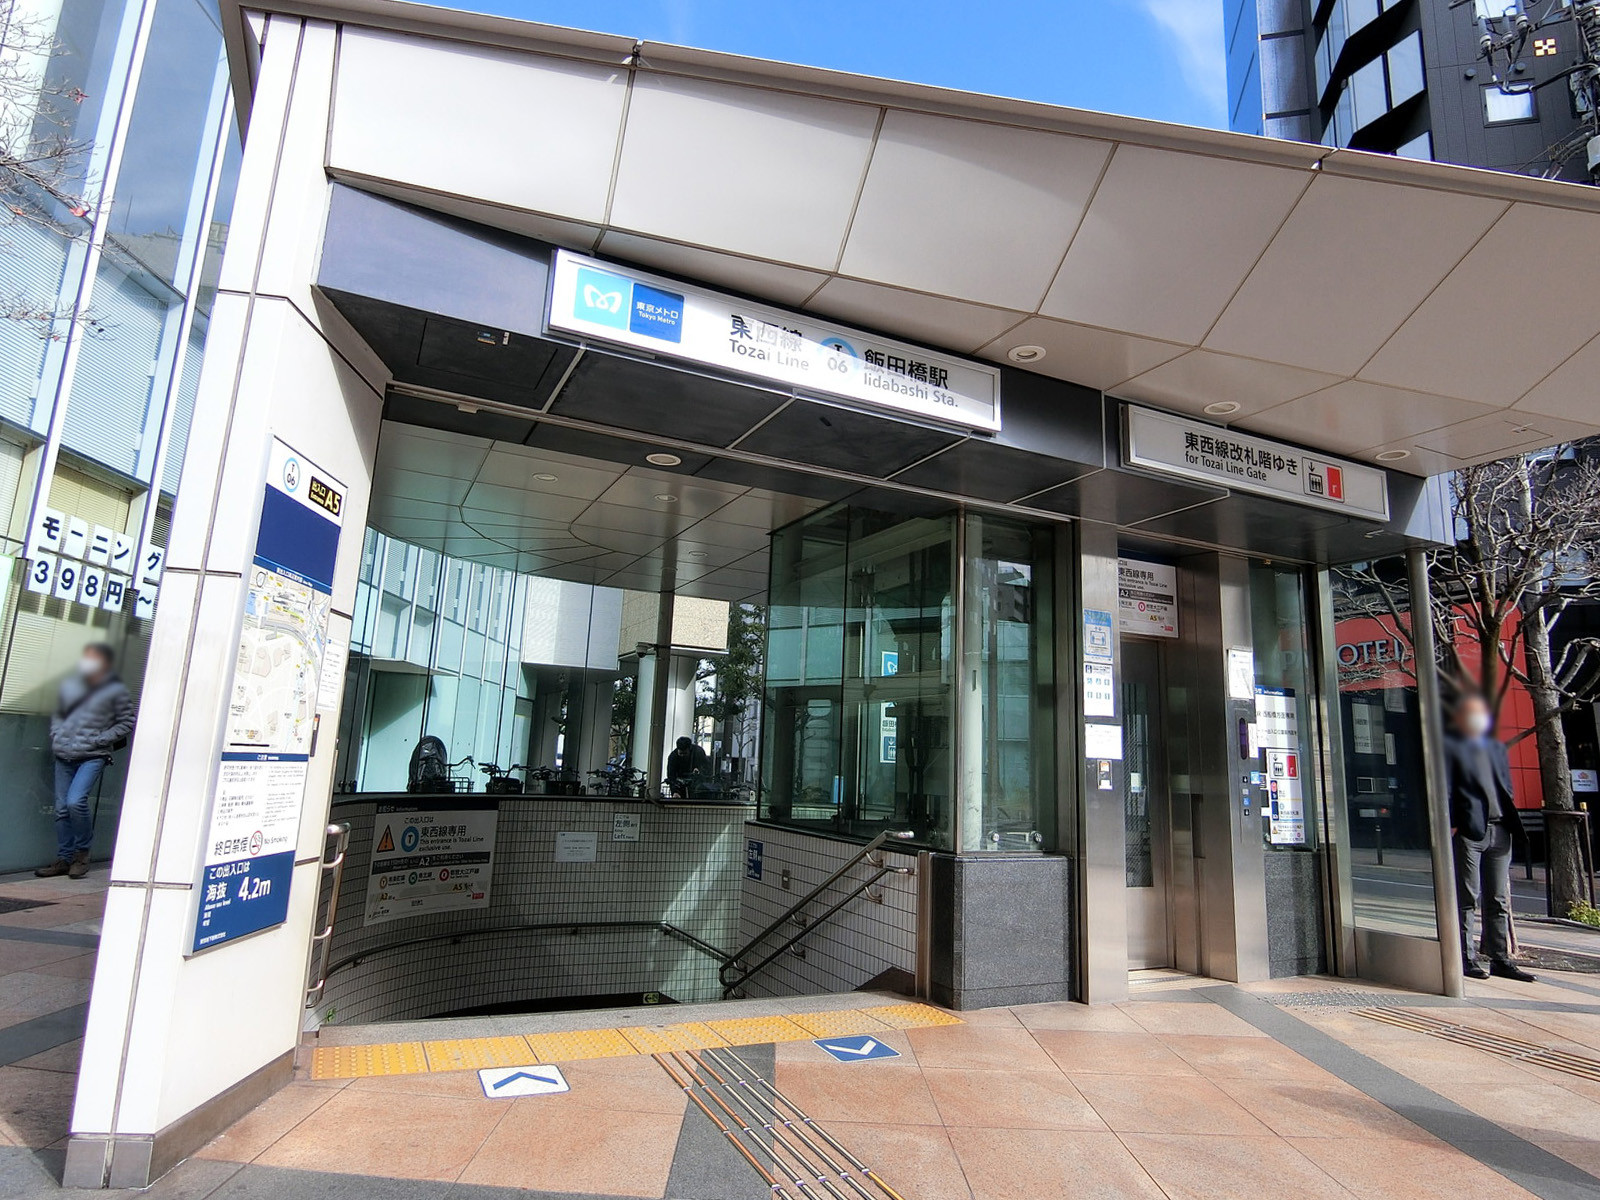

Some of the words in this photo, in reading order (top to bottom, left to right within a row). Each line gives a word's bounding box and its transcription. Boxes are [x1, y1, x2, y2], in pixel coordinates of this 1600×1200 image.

[636, 301, 679, 319] 東京メトロ
[638, 310, 657, 322] Tokyo
[657, 315, 676, 326] Metro
[729, 338, 771, 361] Tozai
[777, 350, 809, 371] Line
[827, 356, 848, 374] 06
[864, 348, 948, 390] 飯田橋駅
[863, 372, 928, 400] Iidabashi
[933, 389, 958, 408] Sta.
[1184, 431, 1298, 476] 東西線改札階ゆき
[1184, 450, 1199, 465] for
[1201, 455, 1223, 471] Tozai
[1226, 461, 1244, 476] Line
[1246, 466, 1267, 481] Gate
[324, 489, 341, 514] A5
[42, 516, 162, 571] モーニング
[1120, 589, 1129, 597] A2
[420, 825, 467, 838] 東西線専用
[209, 861, 251, 880] この出入口は
[419, 857, 430, 866] A2
[205, 881, 228, 902] 海抜
[238, 876, 272, 902] 4.2m
